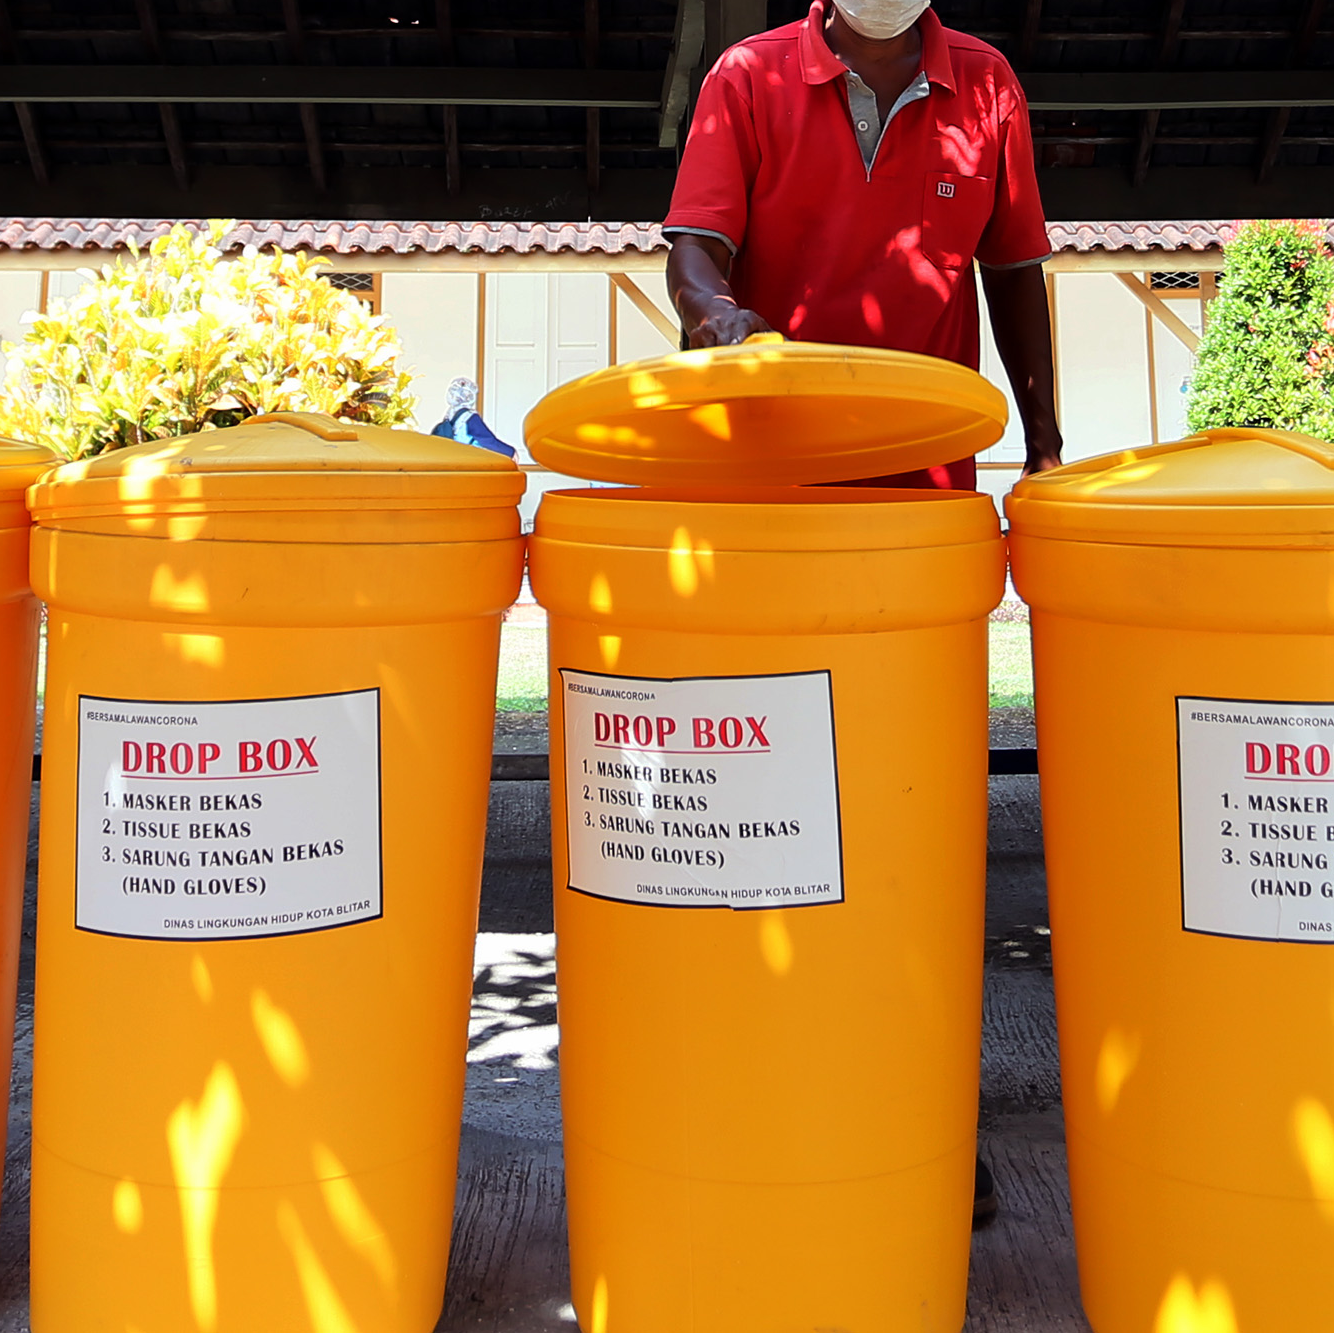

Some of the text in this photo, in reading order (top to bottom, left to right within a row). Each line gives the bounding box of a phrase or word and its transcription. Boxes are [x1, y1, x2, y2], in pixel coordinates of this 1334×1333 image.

[87, 711, 199, 726] #BERSAMALAWANCORONA
[1191, 712, 1334, 727] #BERSAMALAWANCORONA
[594, 712, 771, 748] DROP BOX
[122, 736, 319, 774] DROP BOX
[582, 759, 717, 784] 1. MASKER BEKAS
[103, 791, 262, 811] 1. MASKER BEKAS
[583, 785, 708, 811] 2. TISSUE BEKAS
[1220, 793, 1239, 809] 1.
[1248, 794, 1328, 813] MASKER
[102, 819, 251, 839] 2. TISSUE BEKAS
[584, 811, 800, 839] 3. SARUNG TANGAN BEKAS
[1220, 821, 1240, 837] 2.
[1249, 822, 1317, 841] TISSUE
[102, 839, 344, 867] 3. SARUNG TANGAN BEKAS
[601, 841, 725, 869] (HAND GLOVES)
[1221, 849, 1240, 865] 3.
[1249, 850, 1328, 870] SARUNG
[122, 876, 267, 896] (HAND GLOVES)
[637, 884, 663, 895] DINAS
[731, 889, 762, 898] HIDUP
[765, 886, 792, 897] KOTA
[794, 884, 831, 895] BLITAR
[1251, 879, 1311, 898] (HAND
[164, 900, 370, 928] DINAS LINGKUNGAN HIDUP KOTA BLITAR
[1299, 922, 1332, 932] DINAS
